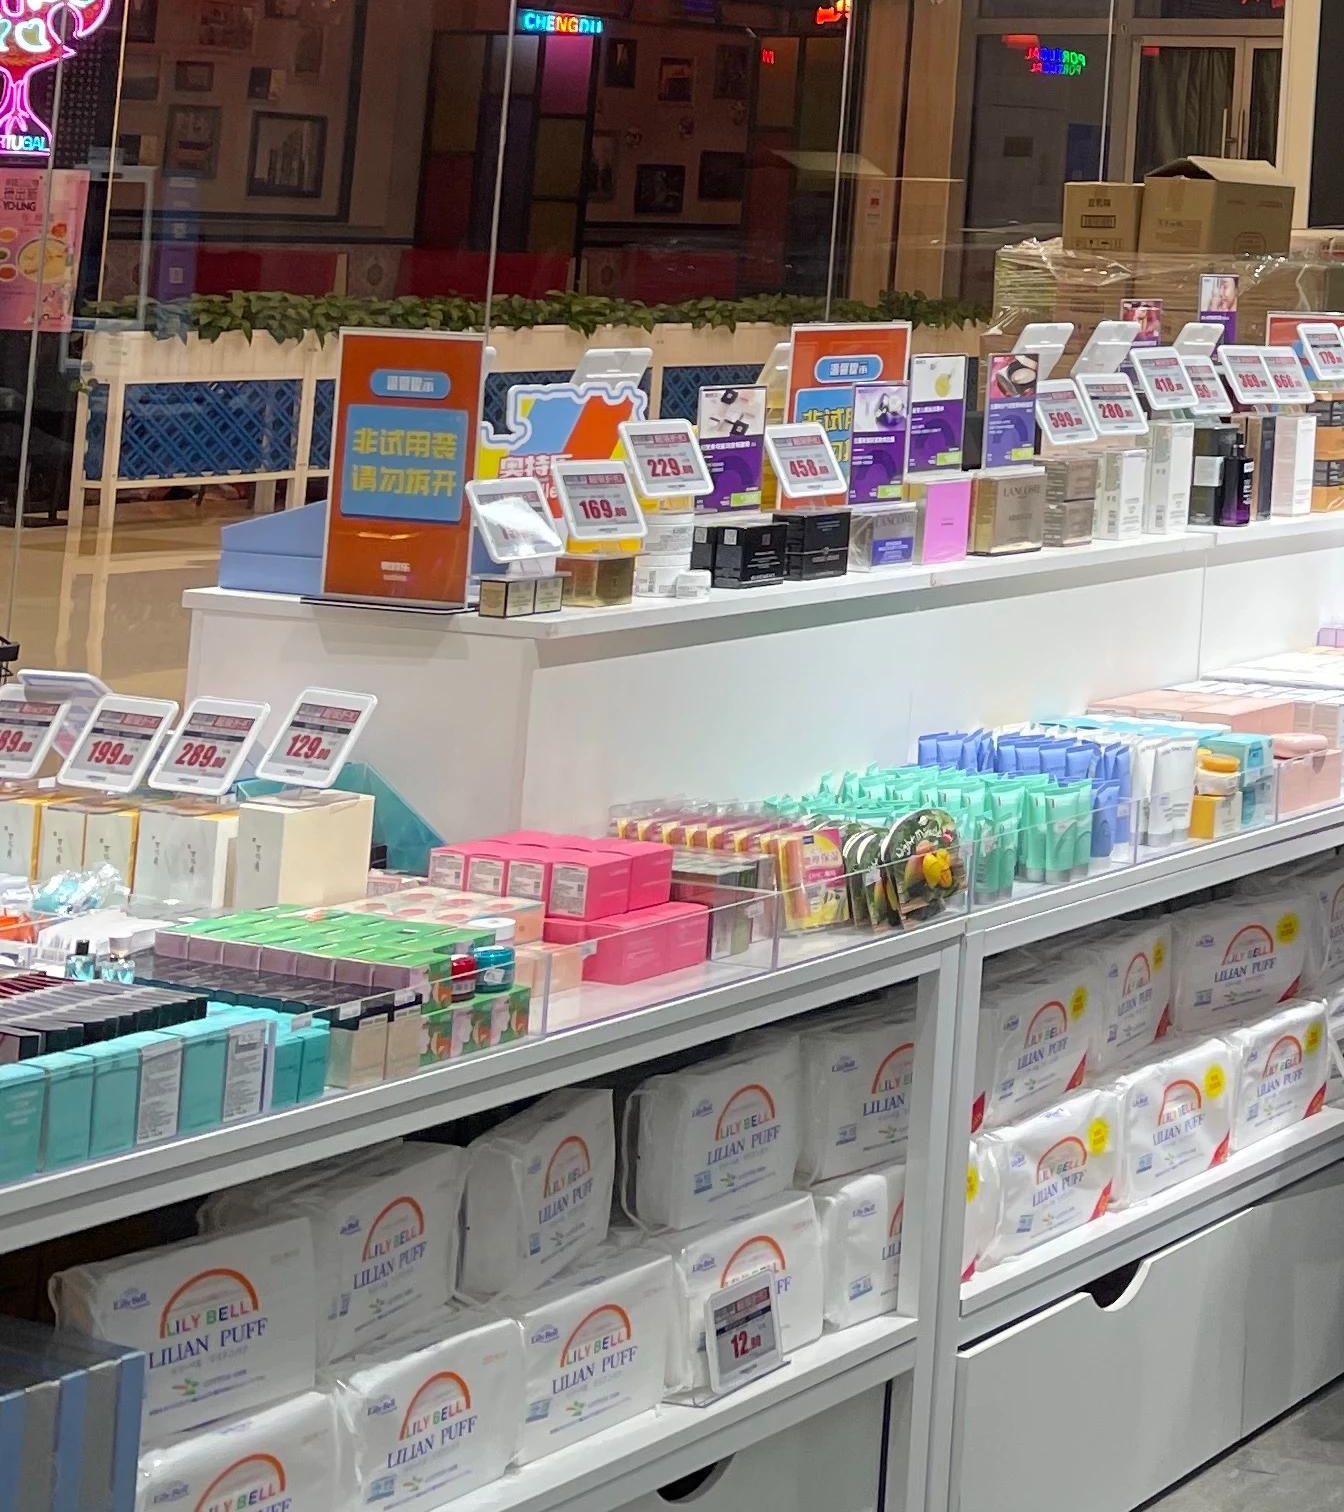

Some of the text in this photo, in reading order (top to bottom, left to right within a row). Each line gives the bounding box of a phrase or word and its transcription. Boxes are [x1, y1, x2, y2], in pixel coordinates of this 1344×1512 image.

[353, 428, 457, 460] 非试用装
[863, 1094, 906, 1116] LILIAN
[707, 1124, 781, 1165] LILIAN PUFF
[538, 1195, 571, 1225] LILIAN
[353, 1240, 428, 1289] LILIAN PUFF
[882, 1237, 903, 1261] LIL
[206, 1302, 250, 1326] BELL
[149, 1317, 269, 1370] LILIAN PUFF
[551, 1346, 638, 1394] LILIAN PUFF
[387, 1414, 478, 1468] LILIAN PUFF
[237, 1483, 277, 1509] BELL
